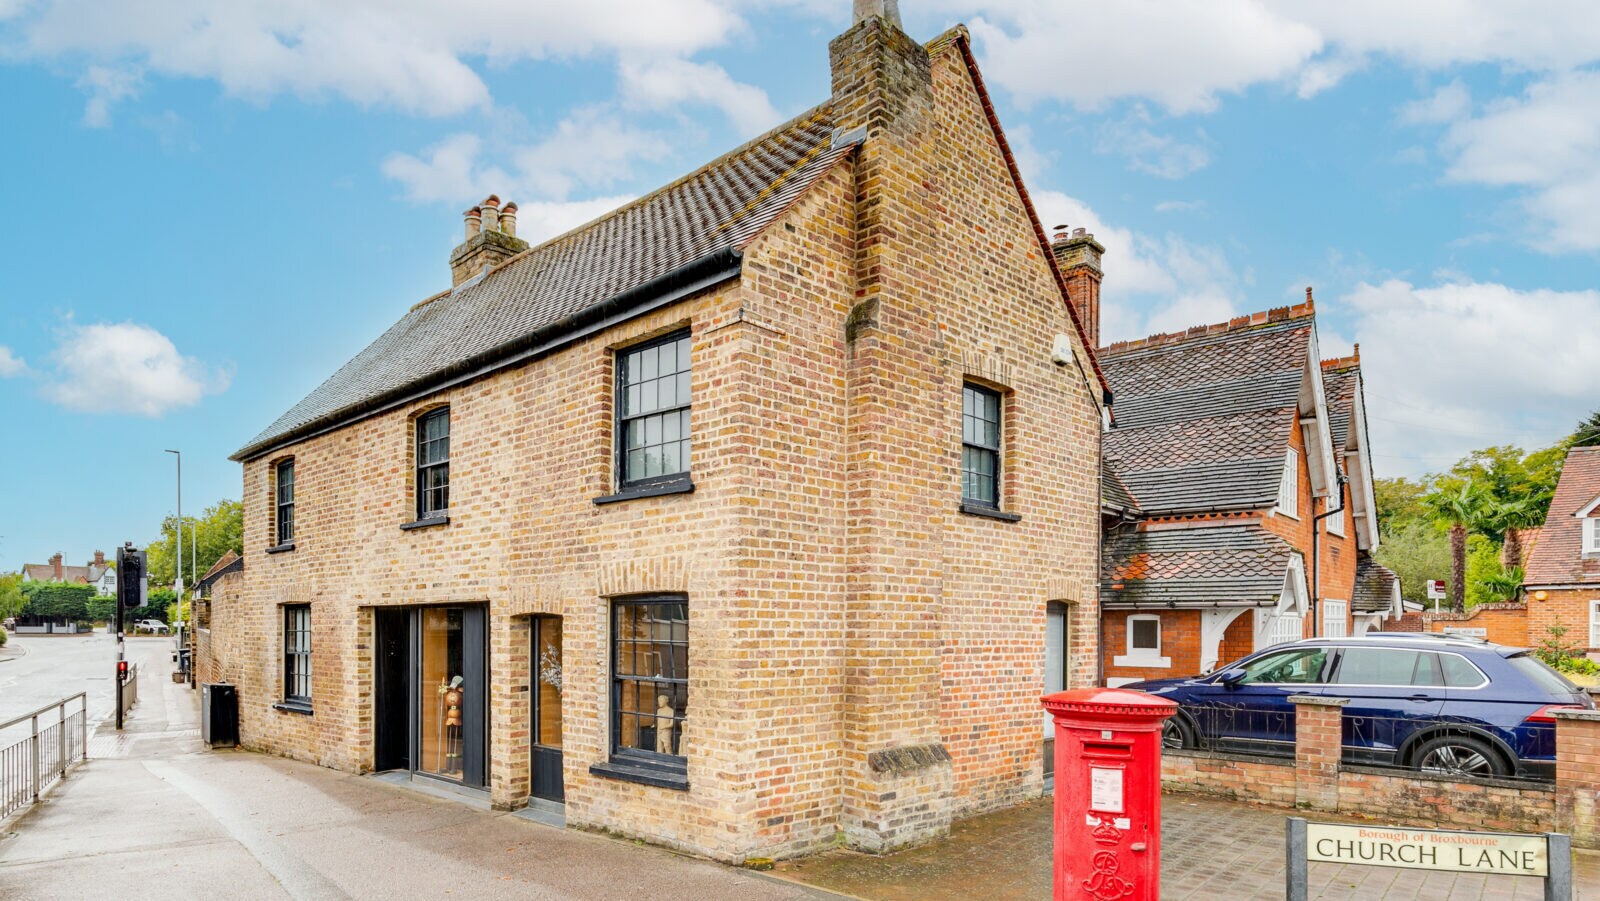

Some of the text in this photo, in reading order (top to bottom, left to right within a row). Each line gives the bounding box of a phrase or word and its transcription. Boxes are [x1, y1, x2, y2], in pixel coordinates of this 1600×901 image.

[1359, 829, 1498, 846] Borough of Broxbourne
[1316, 838, 1535, 870] CHURCH LANE
